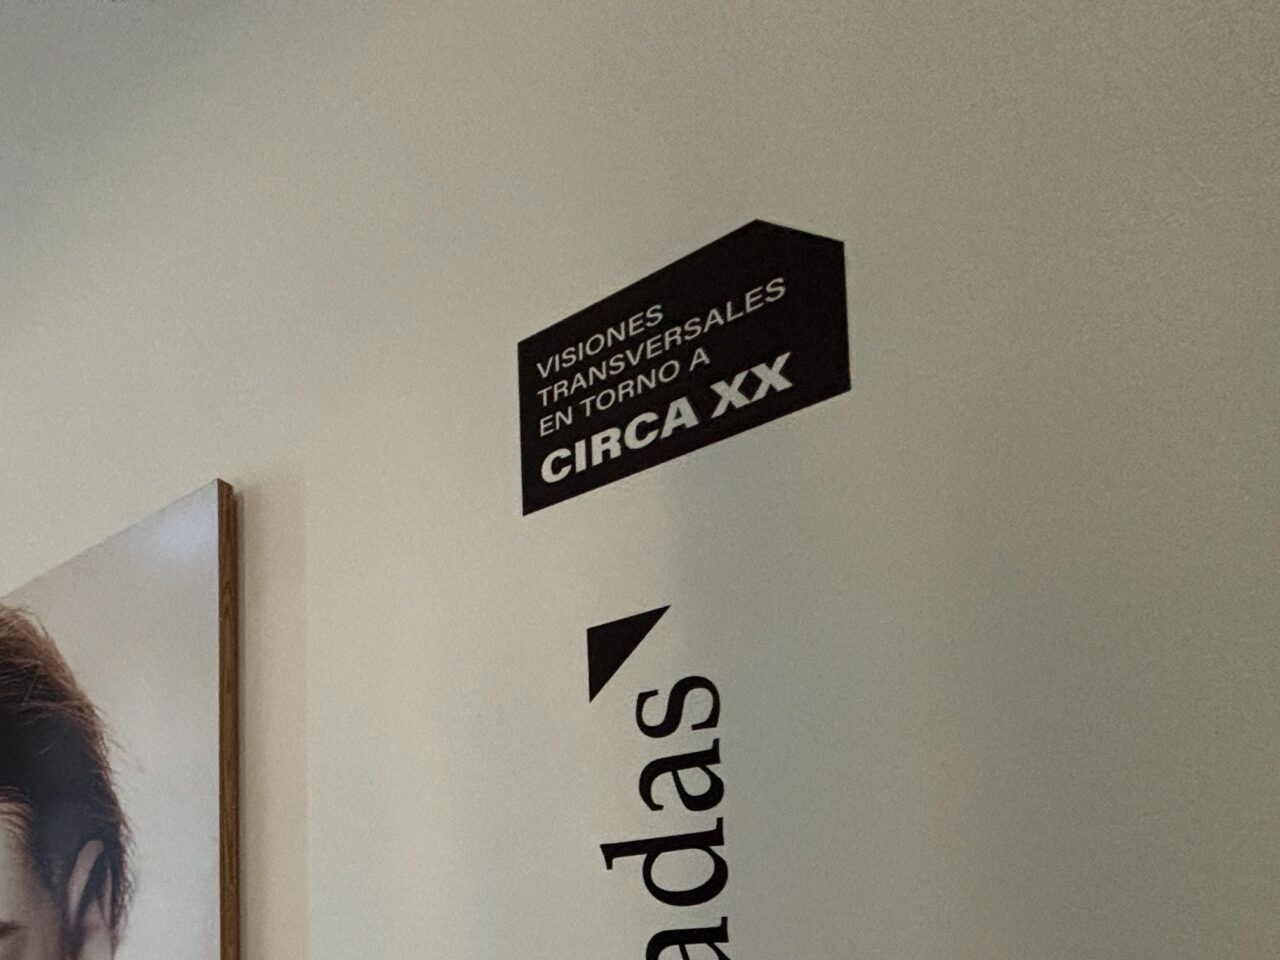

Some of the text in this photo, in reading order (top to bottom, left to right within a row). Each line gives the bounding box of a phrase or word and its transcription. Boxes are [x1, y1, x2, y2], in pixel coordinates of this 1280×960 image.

[536, 304, 664, 378] VISIONES
[537, 277, 787, 407] TRANSVERSALES
[539, 347, 711, 437] EN TORNO A
[540, 352, 793, 484] CIRCA XX
